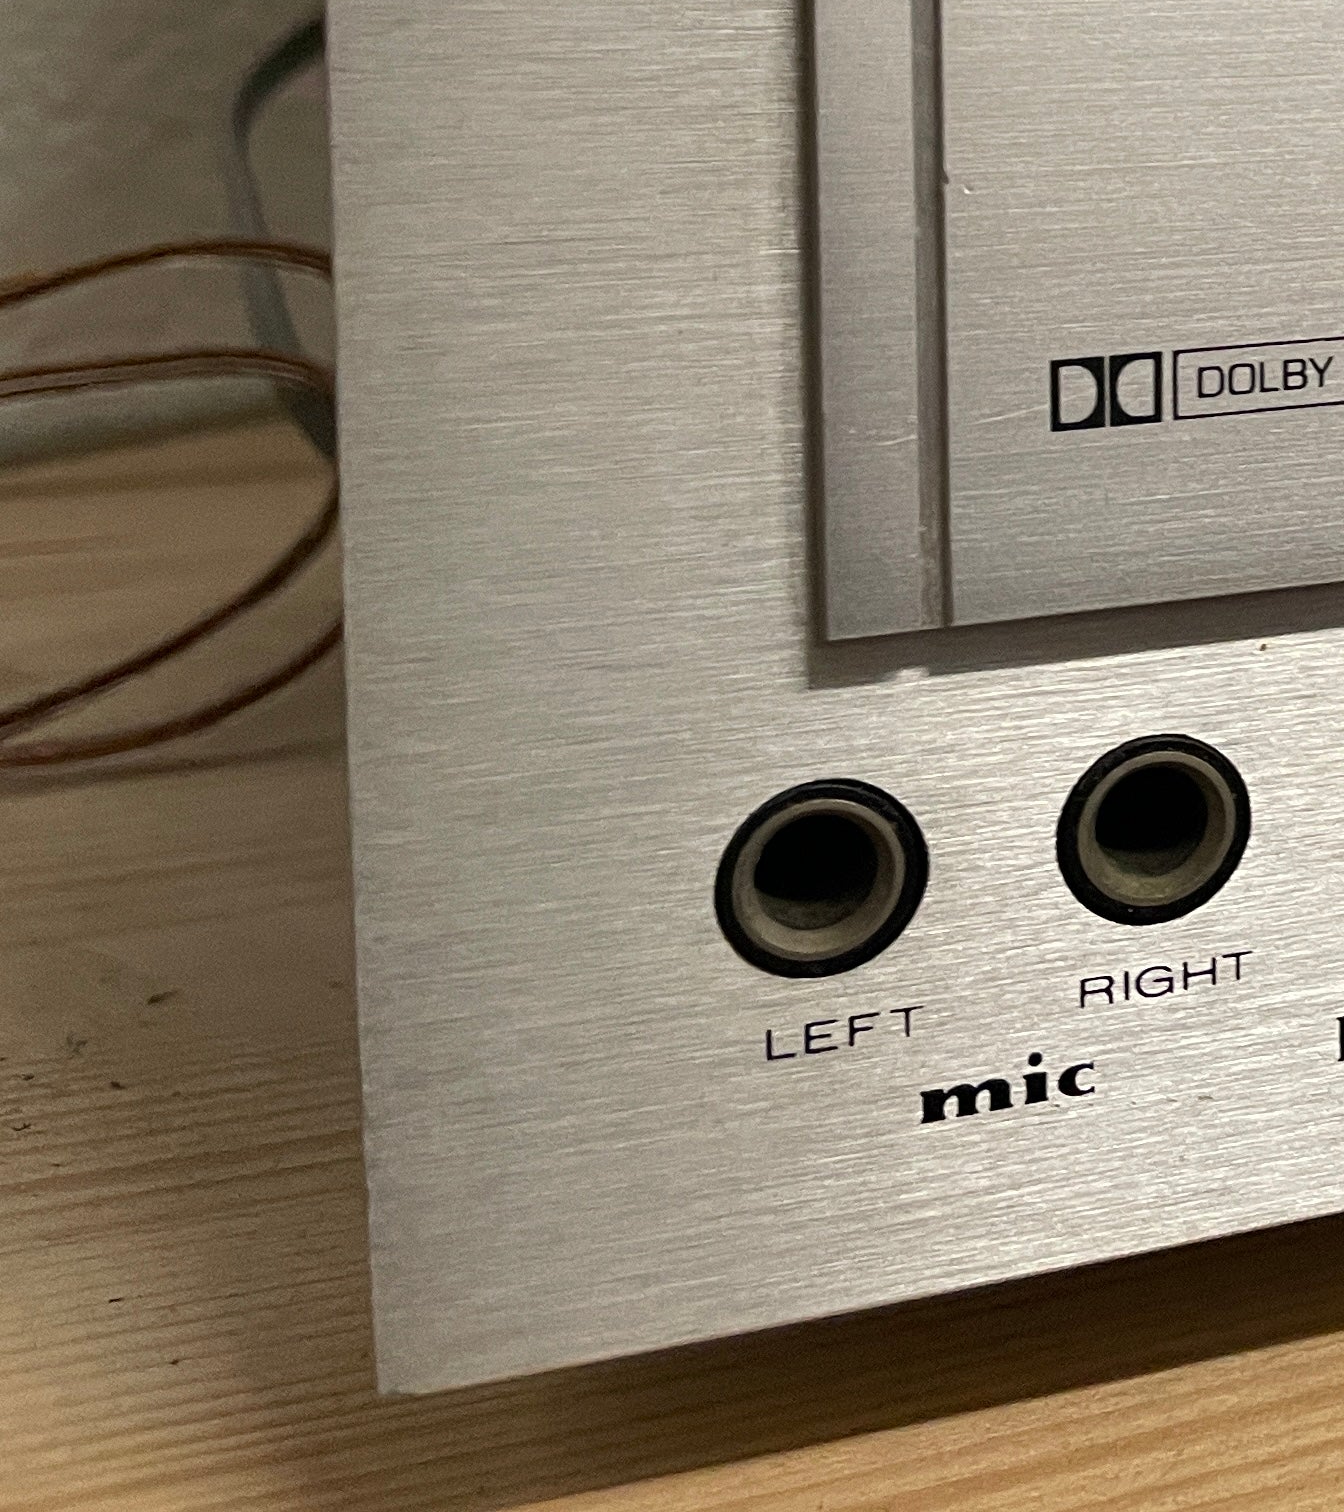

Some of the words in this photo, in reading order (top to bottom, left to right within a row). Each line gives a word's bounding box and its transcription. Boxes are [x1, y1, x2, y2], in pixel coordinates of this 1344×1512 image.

[1196, 355, 1335, 400] DOLBY
[1078, 950, 1254, 1008] RIGHT
[764, 1004, 925, 1061] LEFT
[919, 1051, 1097, 1125] mic
